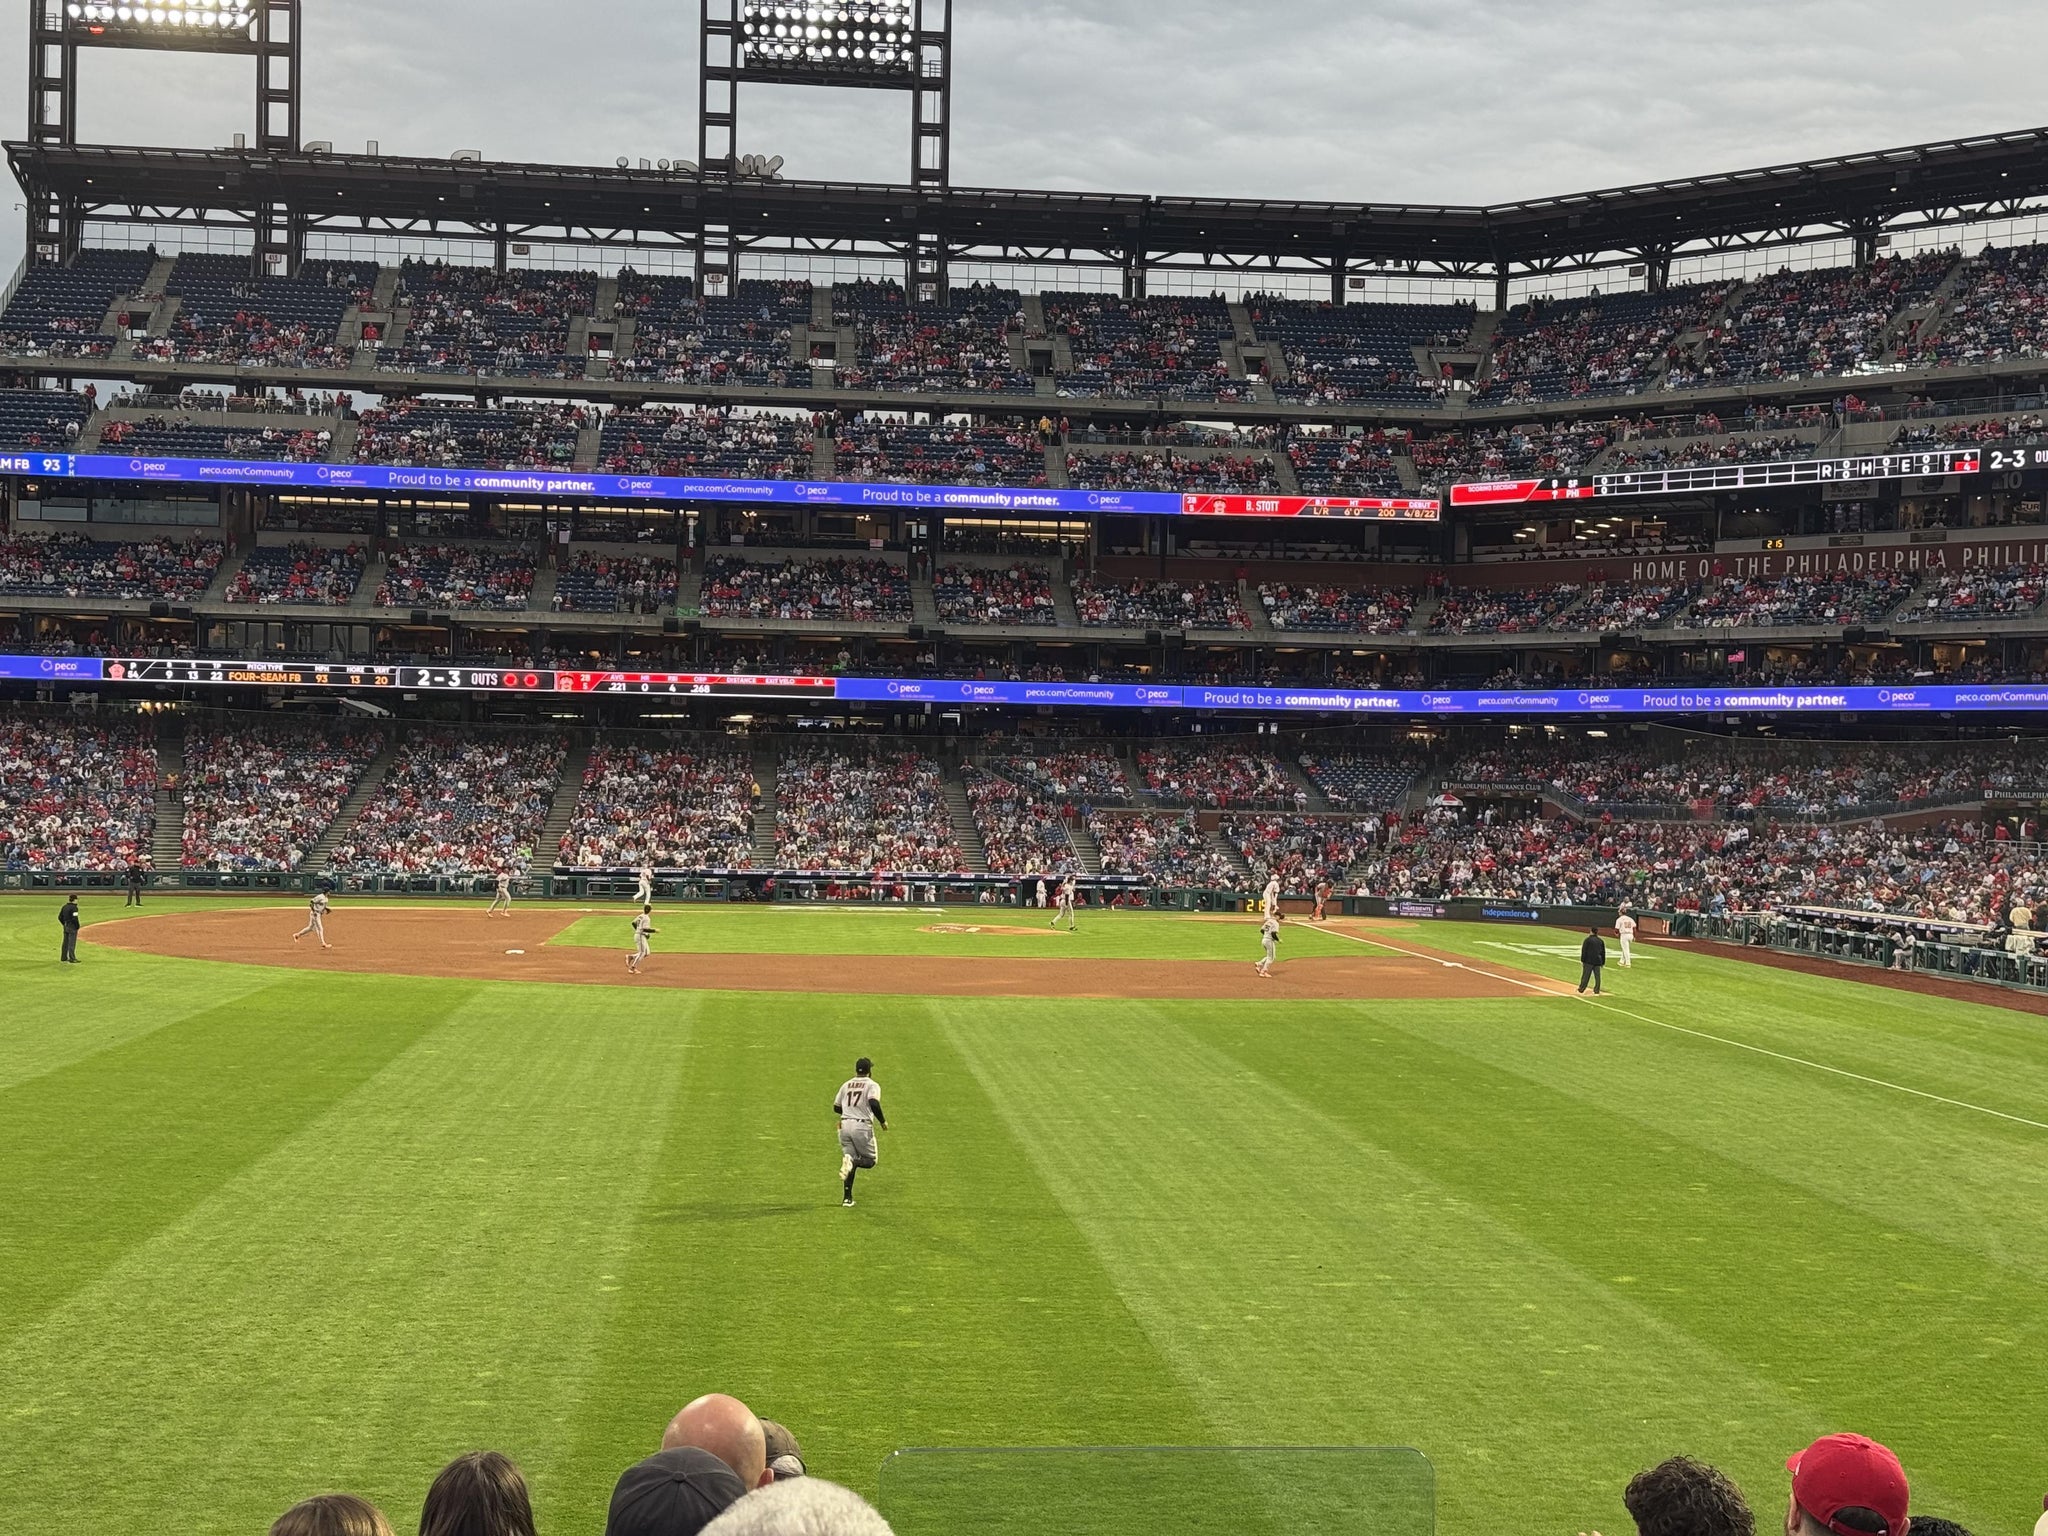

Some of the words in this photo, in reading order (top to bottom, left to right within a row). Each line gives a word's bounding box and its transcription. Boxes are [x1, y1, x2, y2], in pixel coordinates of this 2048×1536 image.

[1842, 460, 1850, 468] 0
[1882, 458, 1890, 466] 0
[1922, 455, 1930, 464] 0
[1990, 450, 2026, 469] 2-3
[0, 458, 11, 470] M
[14, 459, 30, 470] FB
[43, 460, 60, 472] 93
[144, 464, 166, 472] peco
[1862, 462, 1872, 475] H
[1902, 459, 1910, 472] E
[1922, 465, 1930, 474] 0
[200, 466, 294, 480] peco.com/Community
[330, 470, 352, 479] peco
[1822, 466, 1832, 478] R
[1842, 470, 1850, 478] 0
[388, 472, 425, 484] Proud
[430, 474, 440, 485] to
[445, 474, 460, 486] be
[464, 478, 472, 486] a
[474, 476, 543, 491] community
[547, 479, 595, 494] partner.
[1601, 477, 1608, 485] 0
[1624, 475, 1631, 483] 0
[631, 481, 652, 490] peco
[1568, 480, 1578, 488] SF
[684, 485, 773, 498] peco.com/Community
[808, 487, 828, 496] peco
[1566, 489, 1579, 498] PHI
[1601, 486, 1608, 494] 0
[863, 489, 897, 501] Proud
[902, 491, 913, 502] to
[916, 490, 932, 502] be
[934, 495, 942, 503] a
[944, 493, 1010, 508] community
[1014, 496, 1060, 510] partner.
[1100, 498, 1120, 506] peco
[1246, 500, 1254, 510] B.
[1256, 501, 1280, 512] STOTT
[1314, 508, 1329, 516] L/R
[1378, 509, 1396, 517] 200
[1404, 510, 1435, 518] 4/8/22
[1634, 560, 1686, 580] HOME
[1735, 556, 1772, 577] THE
[1786, 548, 1946, 574] PHILADELPHIA
[55, 662, 77, 672] peco
[166, 670, 173, 678] 9
[188, 670, 198, 680] 13
[210, 672, 222, 680] 22
[228, 672, 287, 682] FOUR-SEAM
[289, 674, 302, 682] FB
[316, 675, 328, 683] 93
[350, 676, 360, 684] 13
[374, 676, 388, 684] 20
[472, 672, 498, 686] OUTS
[608, 682, 626, 692] .221
[641, 684, 649, 692] 0
[669, 684, 676, 692] 4
[691, 684, 710, 693] .268
[974, 686, 994, 694] peco
[1026, 688, 1114, 700] peco.com/Community
[1148, 690, 1168, 698] peco
[1892, 692, 1914, 702] peco
[1204, 692, 1238, 704] Proud
[1242, 694, 1254, 704] to
[1258, 692, 1274, 705] be
[1275, 696, 1282, 705] a
[1284, 695, 1352, 708] community
[1354, 696, 1400, 709] partner.
[1433, 697, 1451, 706] peco
[1478, 695, 1558, 706] peco.com/Community
[1590, 696, 1609, 704] peco
[1644, 694, 1677, 706] Proud
[1681, 696, 1692, 706] to
[1696, 695, 1711, 706] be
[1724, 694, 1794, 708] community
[1797, 694, 1848, 708] partner.
[1482, 908, 1530, 918] Independence
[847, 1091, 862, 1107] 17
